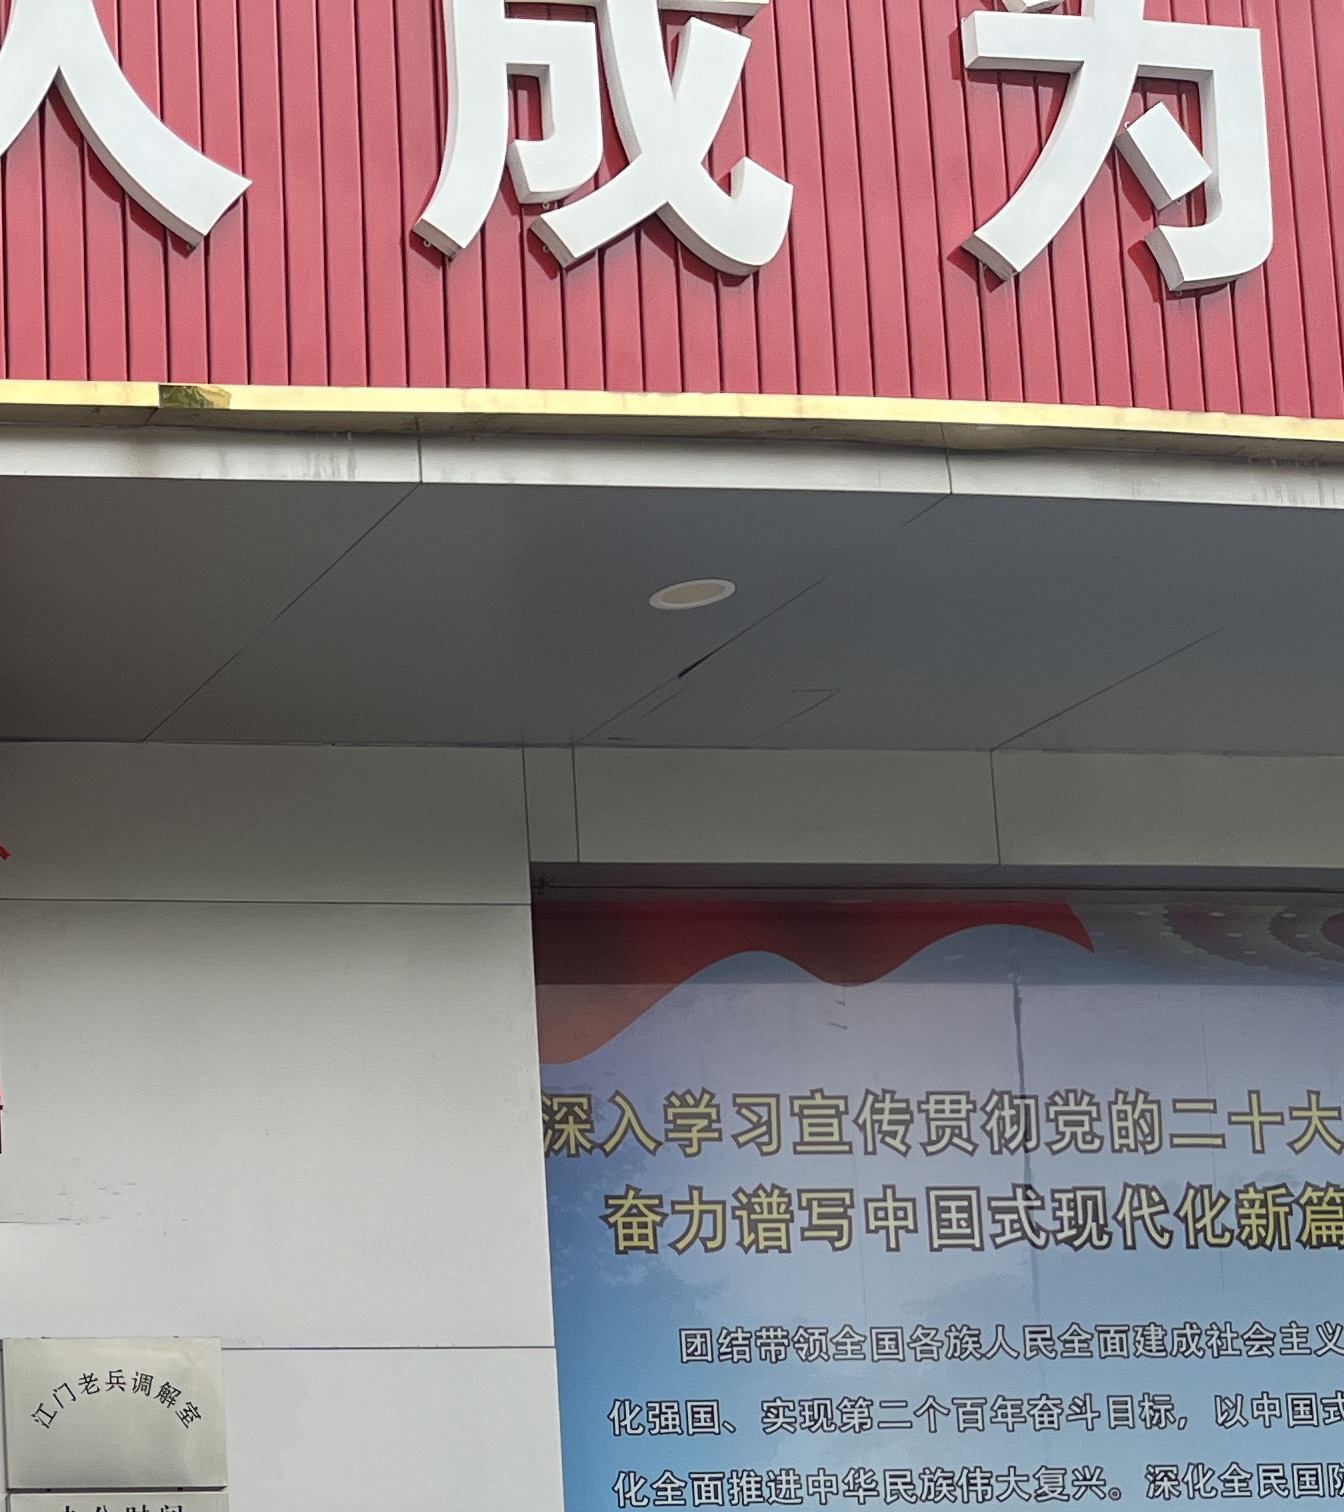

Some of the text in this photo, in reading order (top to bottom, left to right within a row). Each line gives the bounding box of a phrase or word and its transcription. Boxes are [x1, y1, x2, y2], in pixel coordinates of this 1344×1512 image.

[541, 1088, 1344, 1158] 深入学习宣传贯彻党的二十大
[599, 1181, 1344, 1256] 奋力谱写中国式现代化新篇
[678, 1322, 1344, 1364] 团结带领全国各族人民全面建成社会主义
[30, 1369, 202, 1429] 江门老兵调解室
